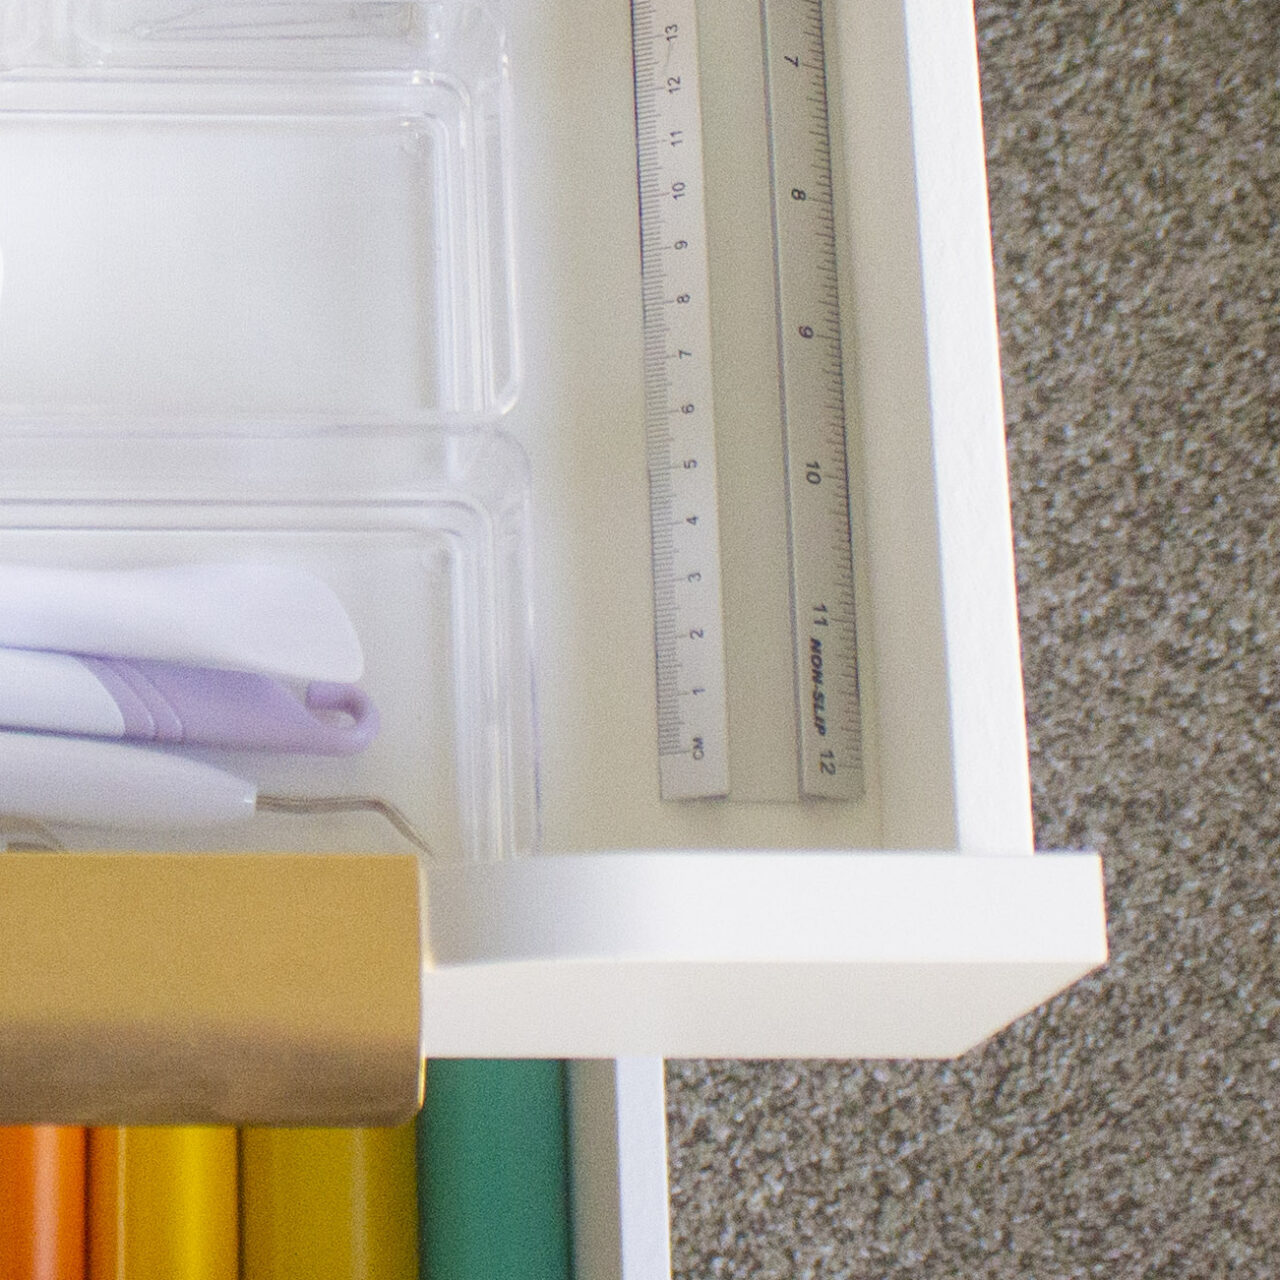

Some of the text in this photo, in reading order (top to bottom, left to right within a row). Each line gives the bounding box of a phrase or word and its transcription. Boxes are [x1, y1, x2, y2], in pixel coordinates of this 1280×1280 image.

[665, 23, 678, 42] 13
[784, 55, 799, 68] 7
[668, 76, 681, 95] 12
[670, 130, 683, 147] 11
[672, 182, 686, 201] 10
[791, 188, 806, 201] 8
[674, 240, 688, 250] 9
[677, 294, 691, 304] 8
[799, 326, 814, 339] 9
[679, 349, 692, 359] 7
[681, 403, 695, 414] 6
[684, 459, 697, 469] 5
[806, 461, 821, 485] 10
[686, 516, 699, 526] 4
[688, 572, 701, 583] 3
[813, 603, 829, 627] 11
[690, 628, 704, 640] 2
[692, 687, 705, 695] 1
[810, 635, 827, 737] NON-SLIP
[693, 737, 704, 760] CM
[820, 750, 836, 776] 12
